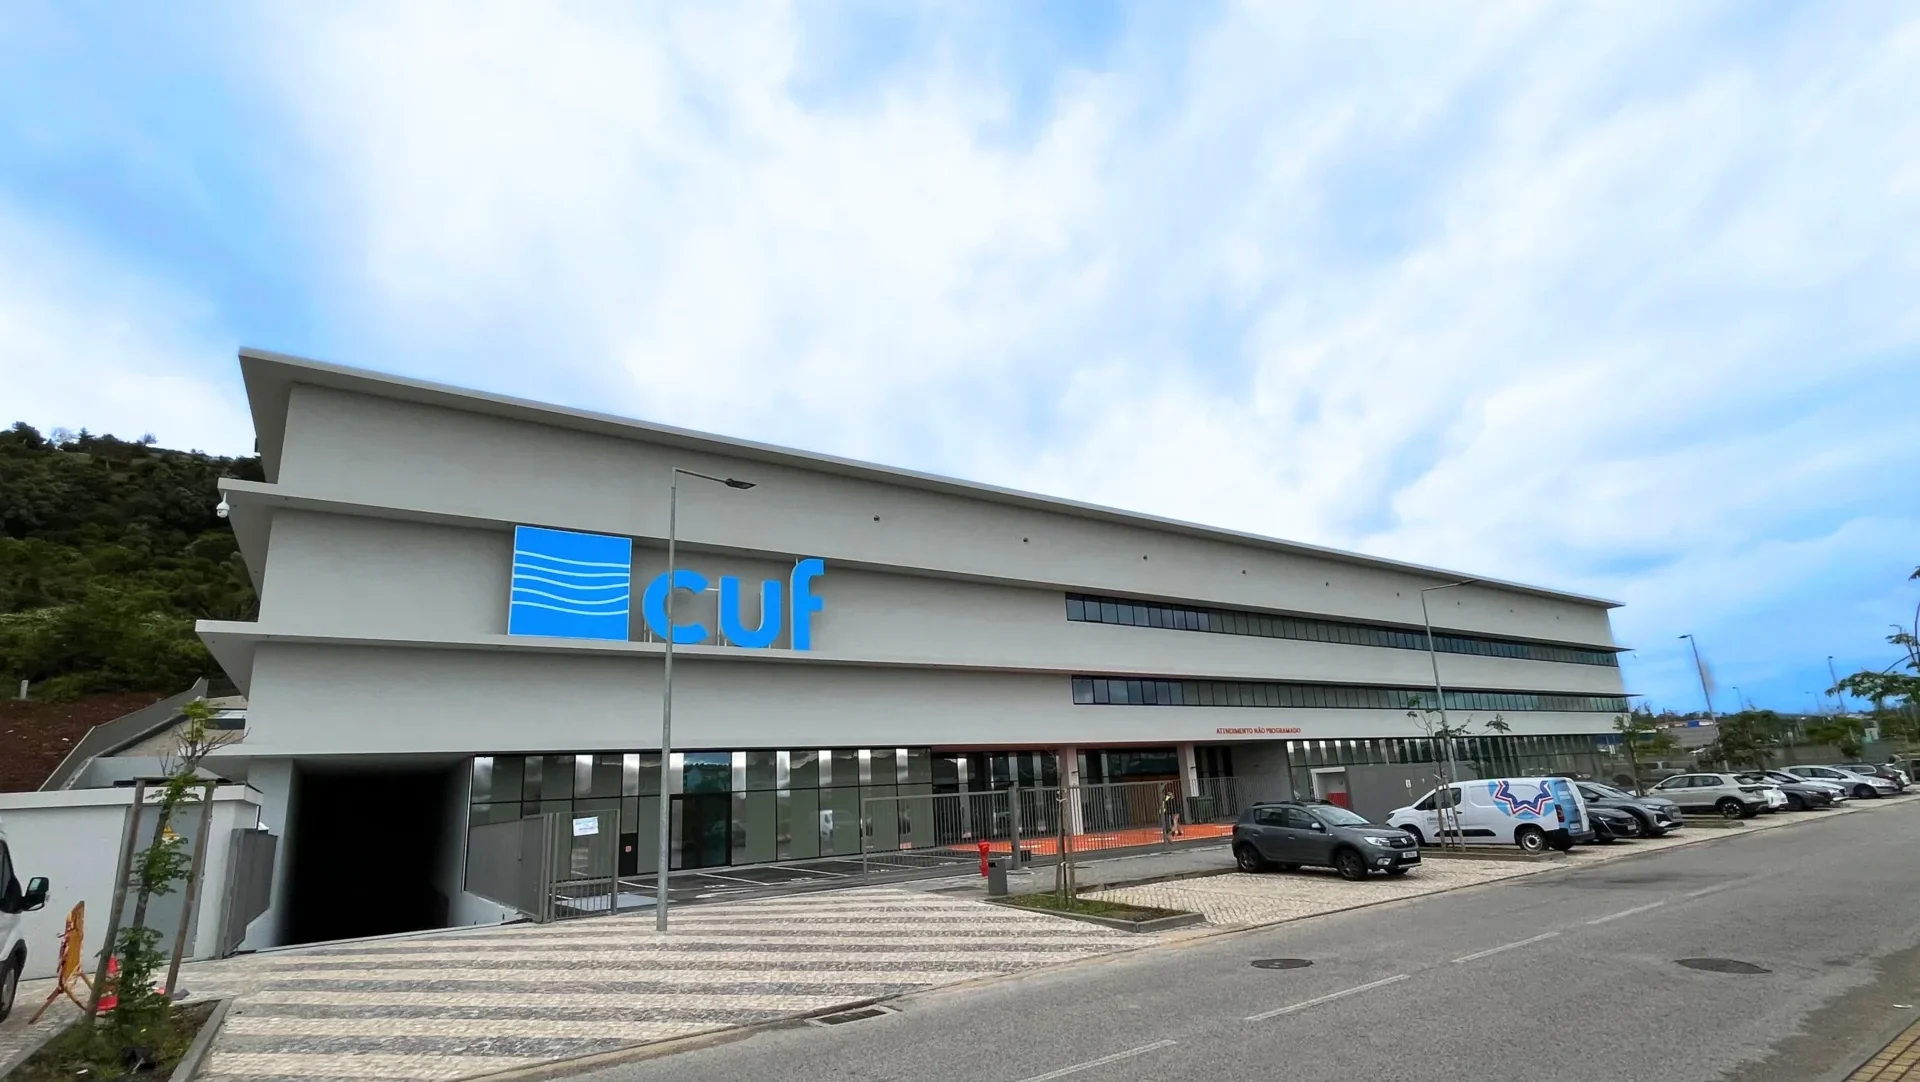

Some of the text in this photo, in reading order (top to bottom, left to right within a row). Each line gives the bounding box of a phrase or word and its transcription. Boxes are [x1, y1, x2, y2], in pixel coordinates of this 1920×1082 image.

[642, 558, 824, 651] cuf
[1216, 727, 1253, 735] ATENDIMENTO
[1254, 726, 1265, 734] NÃO
